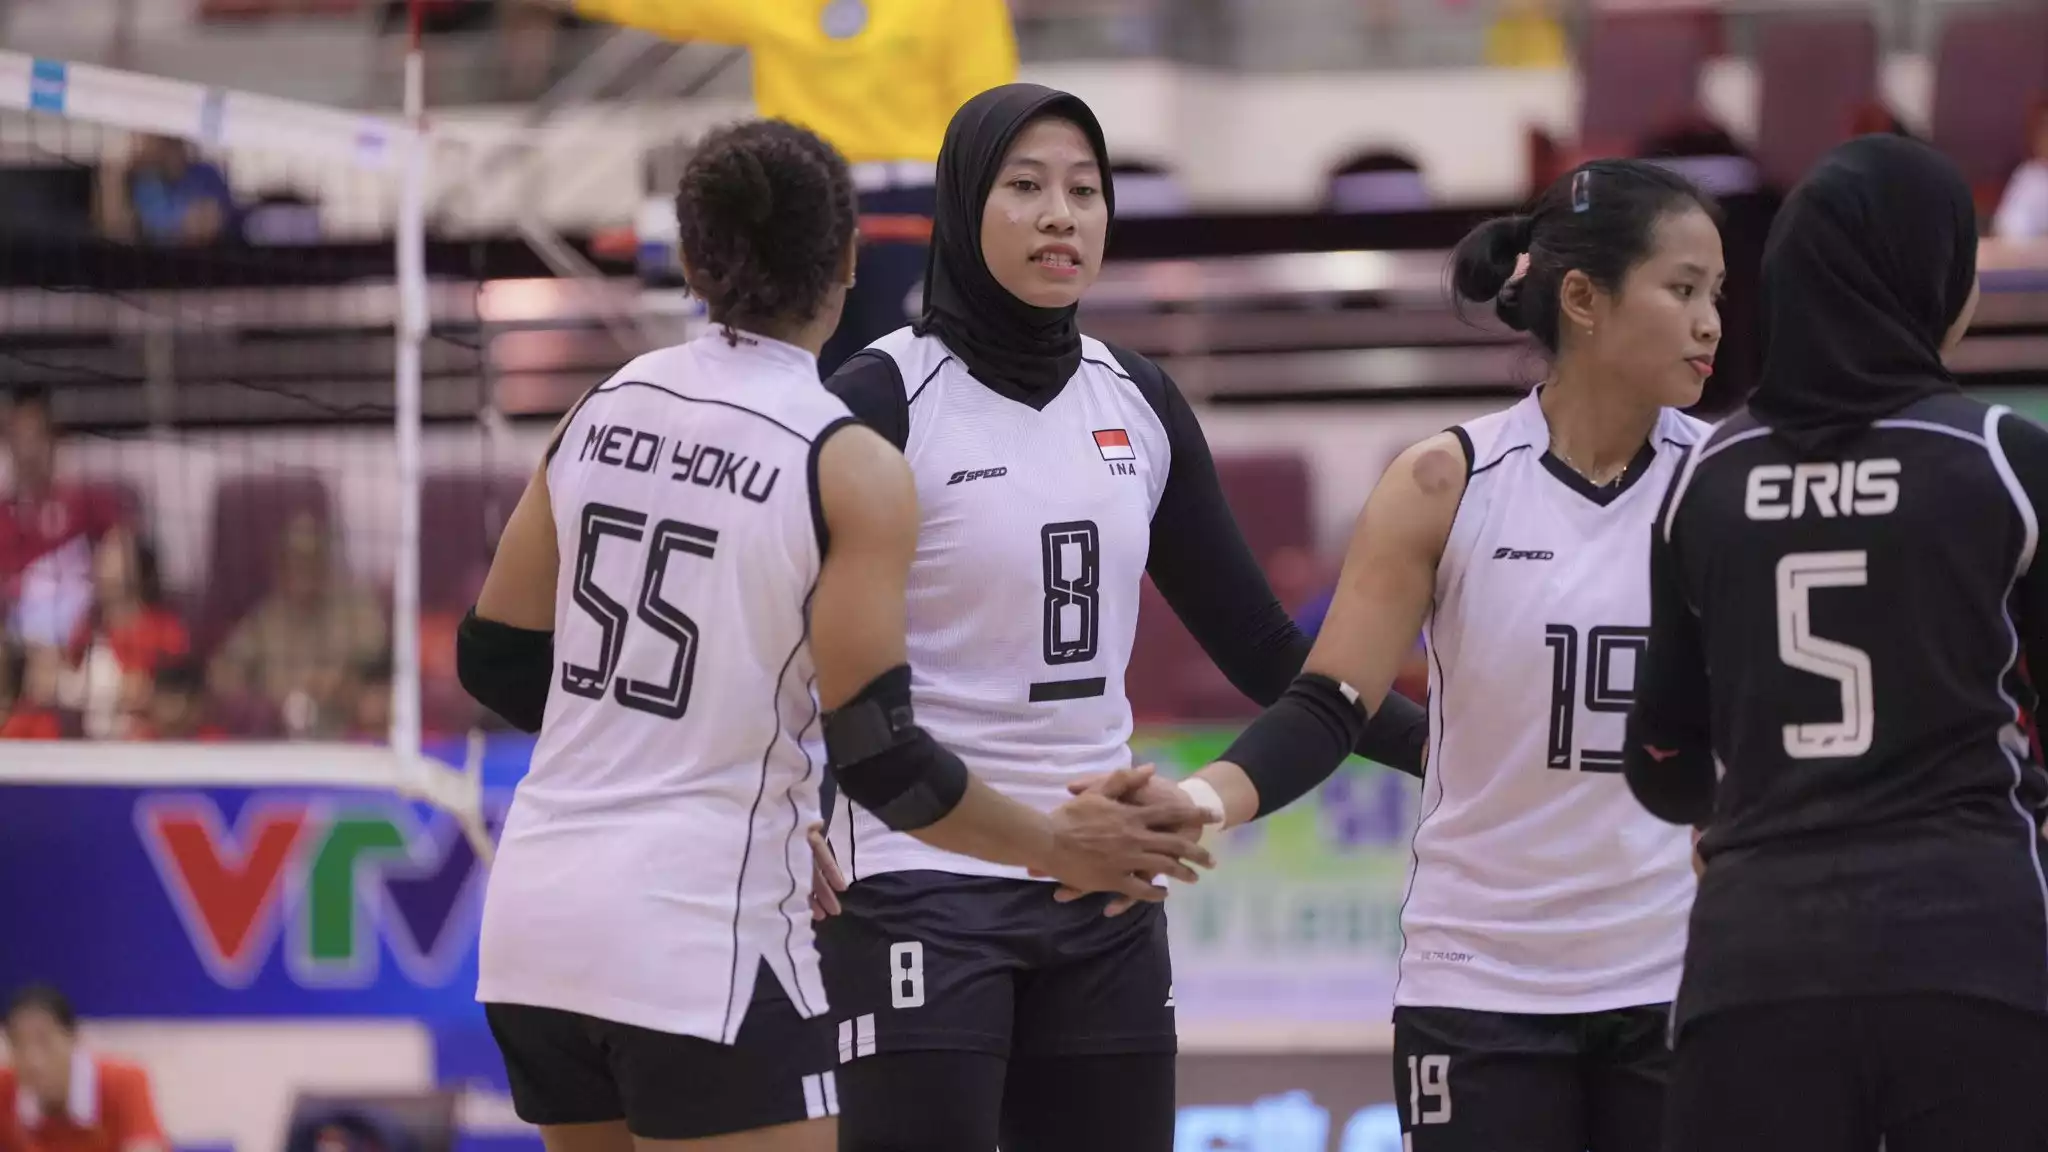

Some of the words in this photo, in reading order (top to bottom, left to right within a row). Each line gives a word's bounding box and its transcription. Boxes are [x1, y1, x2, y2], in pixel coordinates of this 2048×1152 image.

[579, 424, 666, 474] MEDI
[671, 440, 780, 503] YOKU
[965, 466, 1007, 482] SPEED
[1109, 463, 1137, 476] INA
[1744, 458, 1901, 520] ERIS
[561, 502, 718, 720] 55
[1041, 520, 1099, 665] 8
[1776, 550, 1874, 758] 5
[1545, 624, 1652, 773] 19
[148, 806, 482, 970] VTV
[890, 941, 924, 1008] 8
[1408, 1054, 1451, 1125] 19
